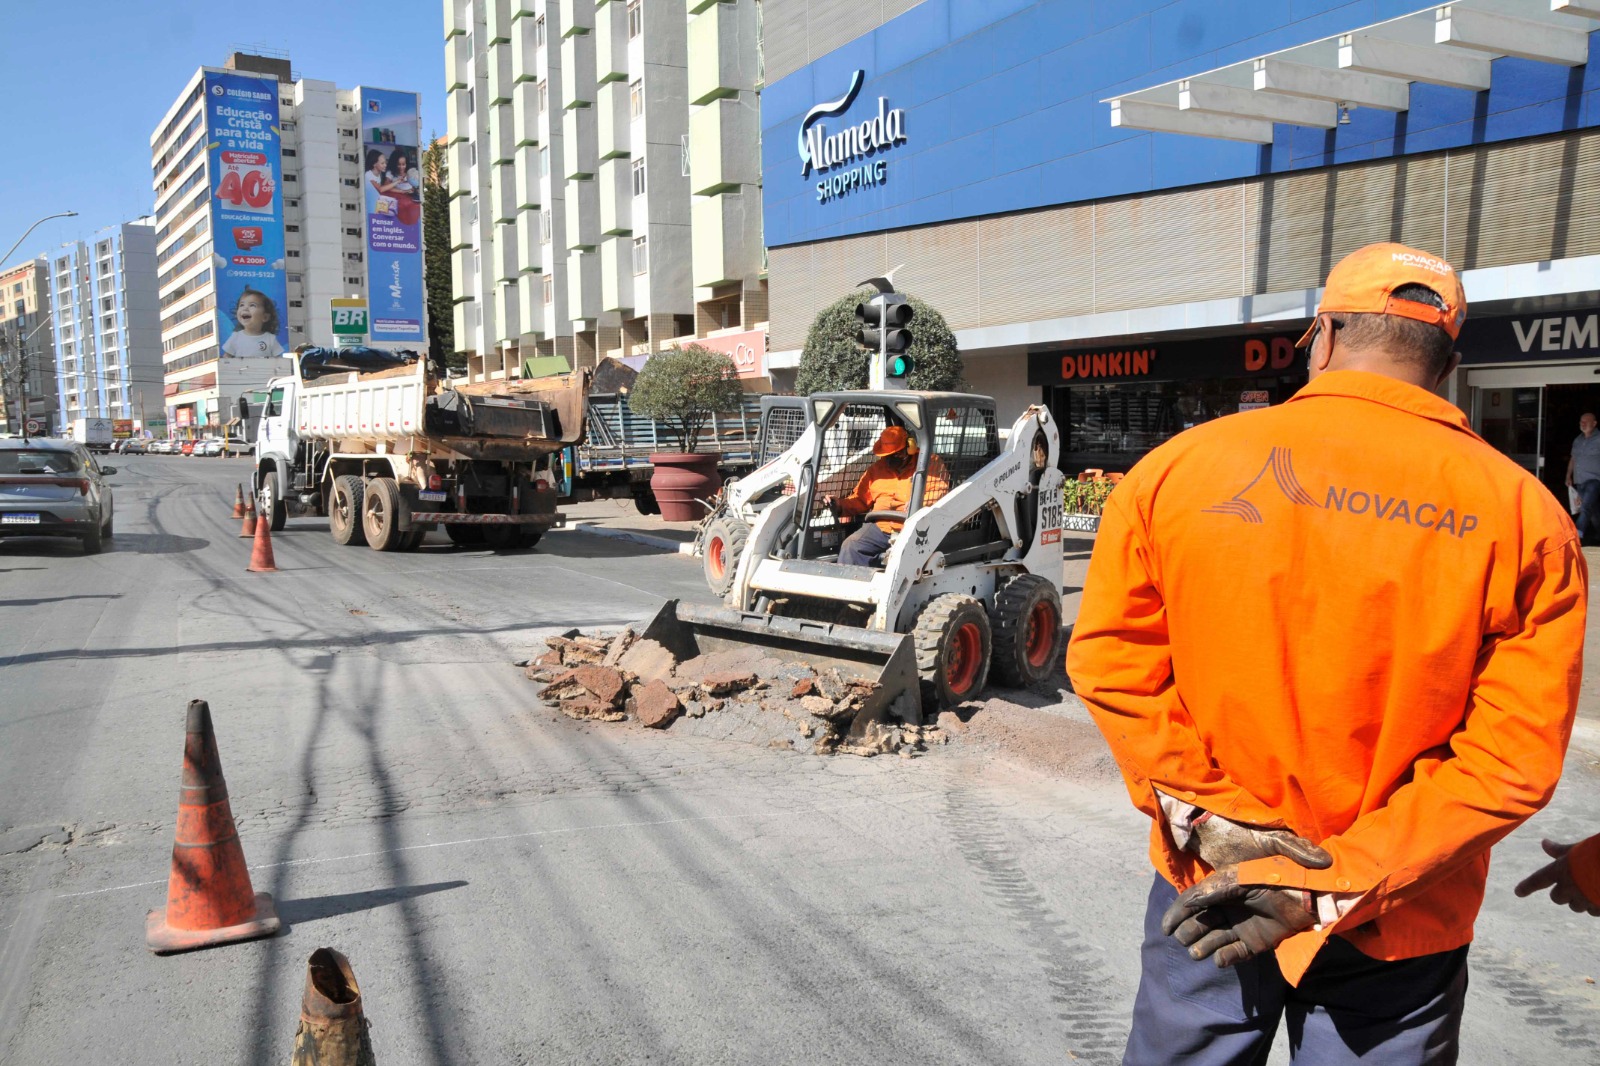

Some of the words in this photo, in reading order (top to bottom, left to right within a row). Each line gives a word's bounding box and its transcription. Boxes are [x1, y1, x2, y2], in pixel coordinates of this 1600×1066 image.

[227, 88, 252, 98] COLÉGIO
[252, 92, 272, 101] SABER
[216, 106, 272, 120] Educação
[228, 118, 262, 129] Cristã
[215, 128, 242, 138] para
[245, 130, 272, 141] toda
[798, 97, 904, 176] Alameda
[239, 139, 264, 150] vida
[816, 161, 884, 201] SHOPPING
[221, 213, 251, 221] EDUCAÇÃO
[372, 233, 404, 241] Conversar
[1392, 252, 1453, 272] NOVACAP
[389, 260, 402, 298] Marista
[334, 310, 364, 325] BR
[1511, 314, 1599, 352] VEM
[1061, 349, 1156, 379] DUNKIN'
[1041, 504, 1062, 529] S185
[1325, 485, 1479, 539] NOVACAP
